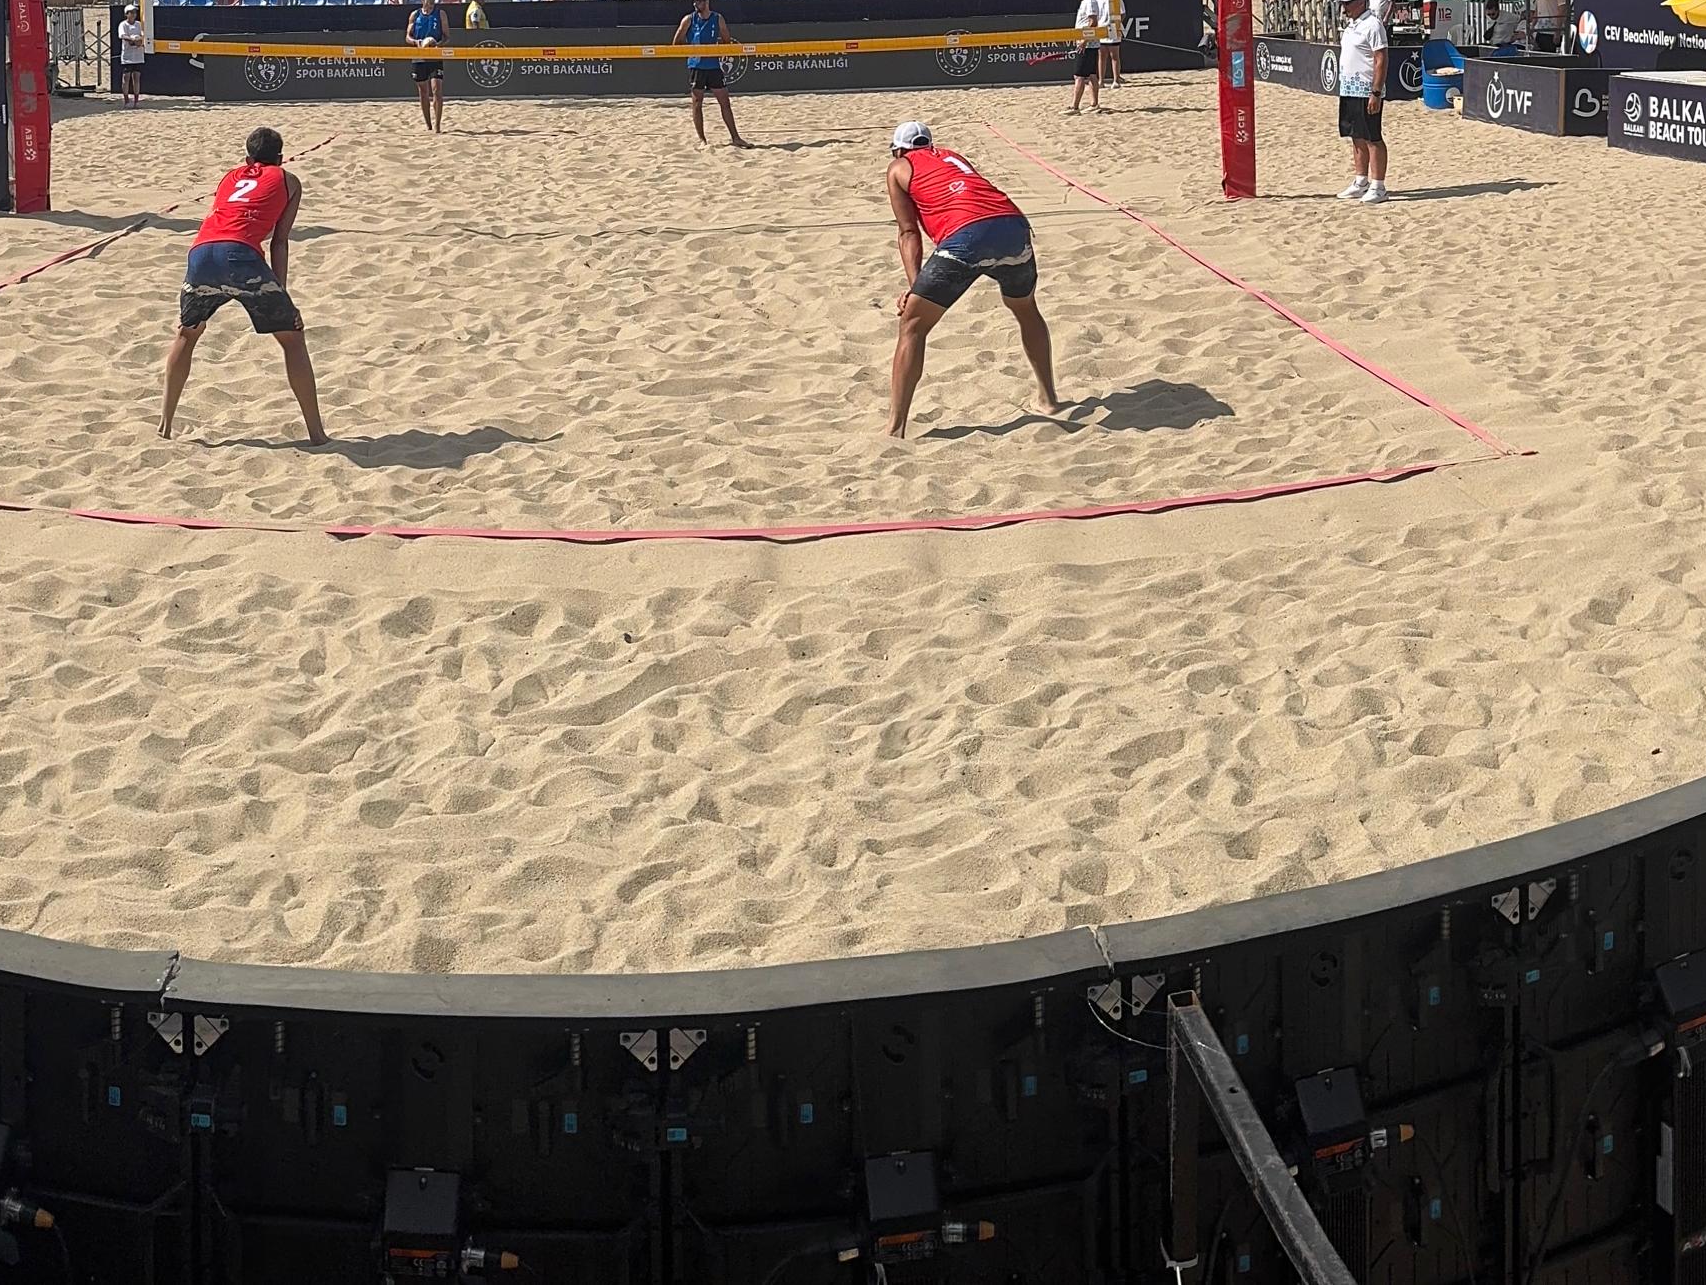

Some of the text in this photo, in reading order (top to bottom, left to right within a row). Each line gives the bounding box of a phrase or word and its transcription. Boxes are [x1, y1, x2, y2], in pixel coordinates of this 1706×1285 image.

[1438, 7, 1453, 20] 112
[1604, 25, 1620, 42] CEV
[1623, 28, 1675, 50] BeachVolley
[754, 57, 849, 71] SPOR BAKANLIĞI
[987, 53, 1016, 64] SPOR
[295, 66, 386, 79] SPOR BAKANLIĞI
[521, 62, 613, 75] SPOR BAKANLIĞI
[1505, 89, 1533, 115] TVF
[1648, 120, 1685, 144] BEACH
[942, 156, 974, 174] 1
[227, 179, 258, 203] 2
